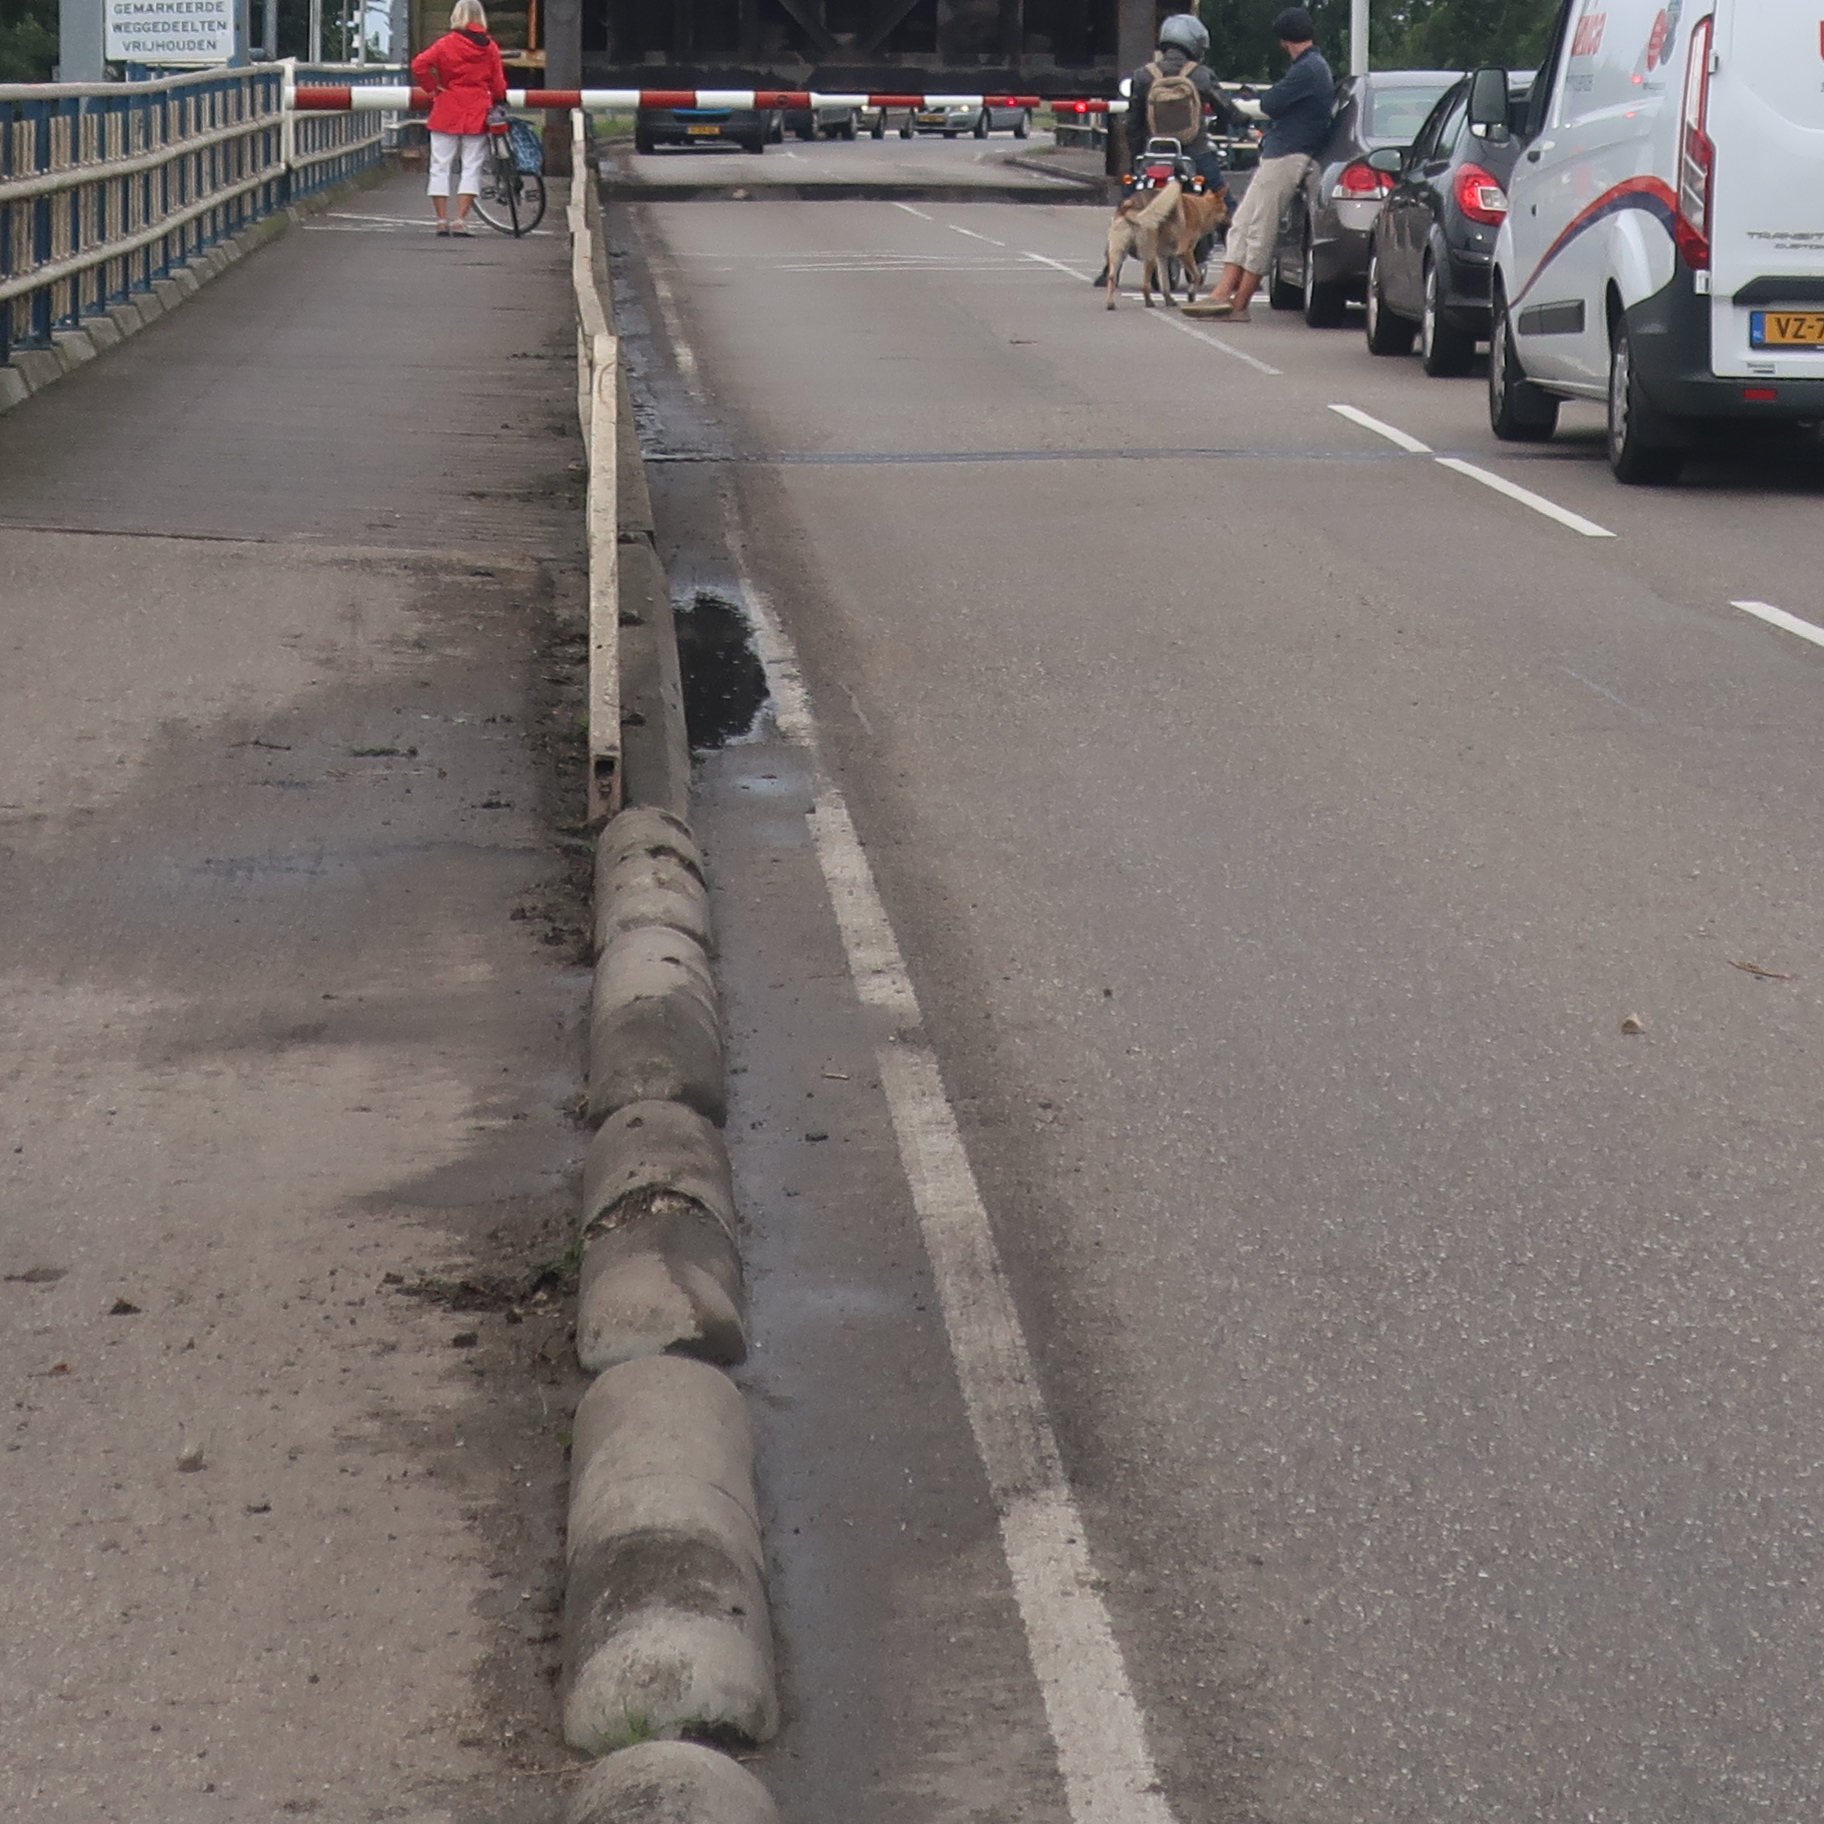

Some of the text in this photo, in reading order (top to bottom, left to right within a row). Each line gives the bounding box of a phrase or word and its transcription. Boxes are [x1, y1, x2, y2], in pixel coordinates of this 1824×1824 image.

[113, 1, 224, 14] GEMARKEERDE
[111, 21, 227, 33] WEGGEDEELTEN
[122, 40, 217, 52] VRIJHOUDEN
